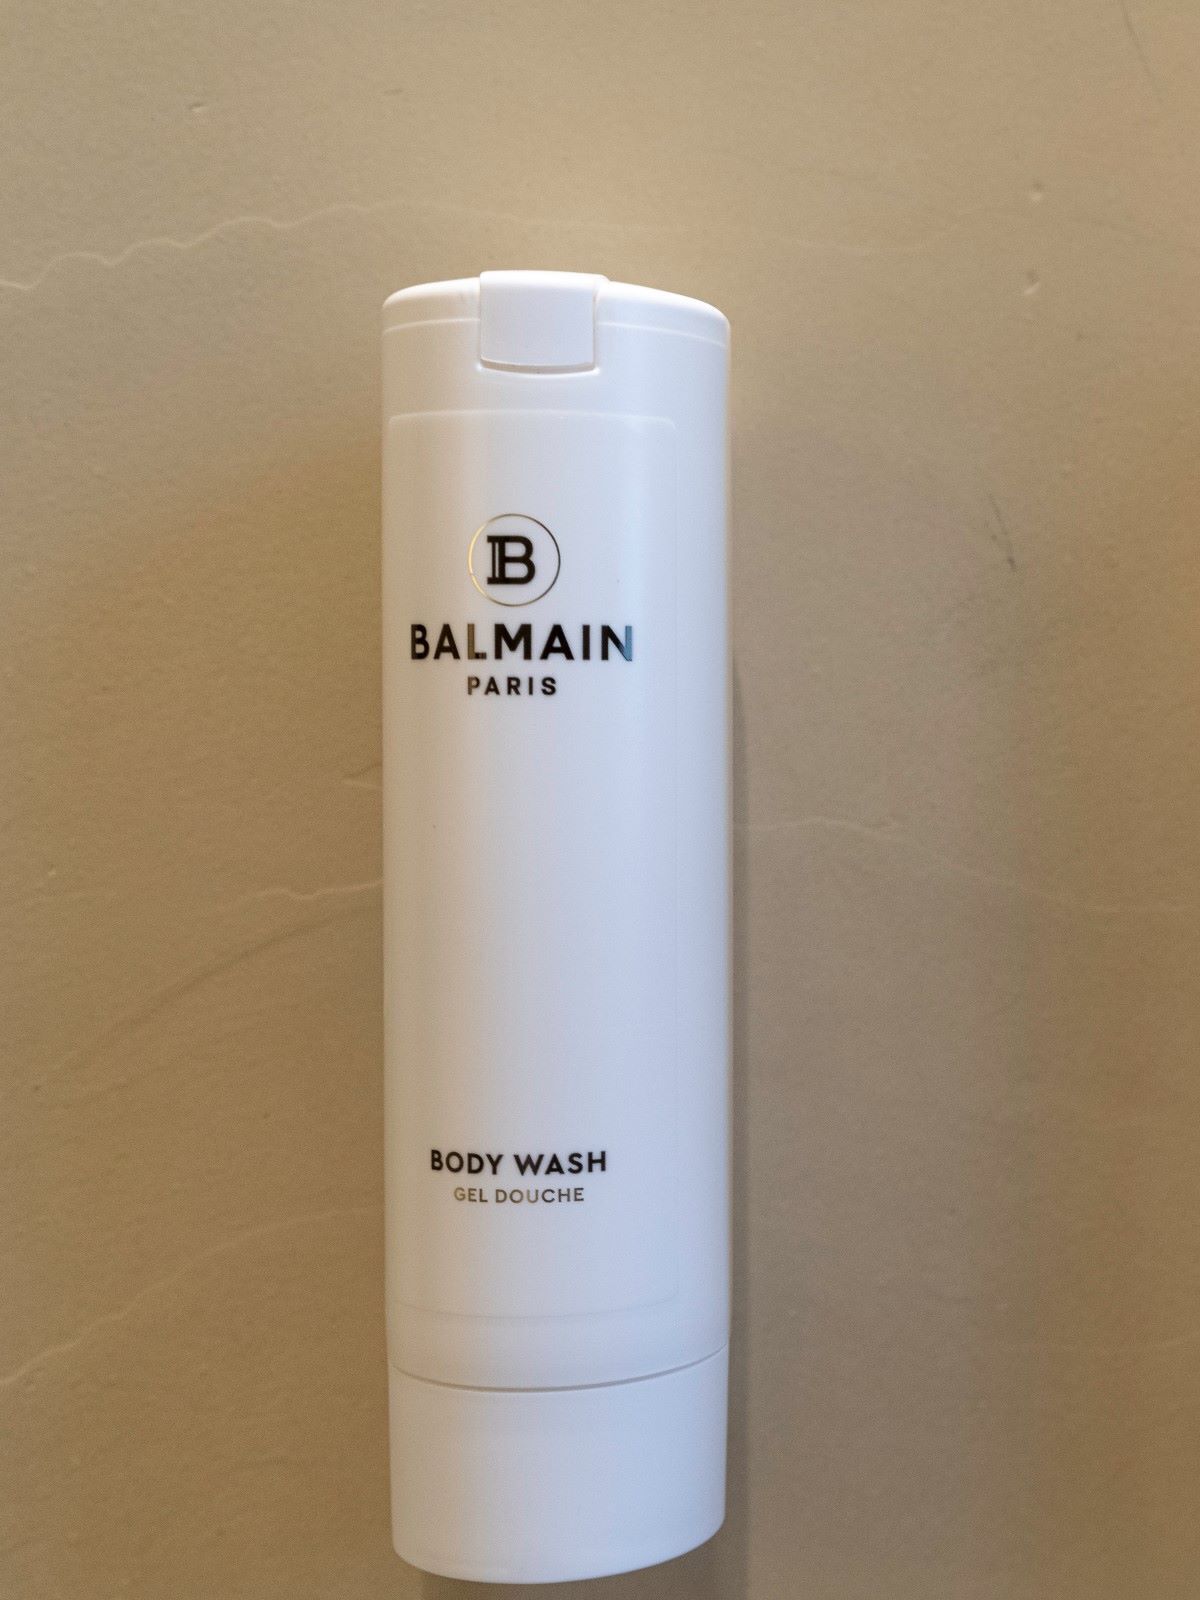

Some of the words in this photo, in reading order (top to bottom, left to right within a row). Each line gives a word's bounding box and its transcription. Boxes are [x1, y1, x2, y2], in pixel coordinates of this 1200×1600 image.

[486, 534, 536, 586] B
[410, 622, 634, 663] BALMAIN
[467, 675, 557, 697] PARIS
[430, 1149, 504, 1176] BODY
[513, 1150, 607, 1177] WASH
[453, 1186, 489, 1203] GEL
[495, 1186, 585, 1204] DOUCHE
